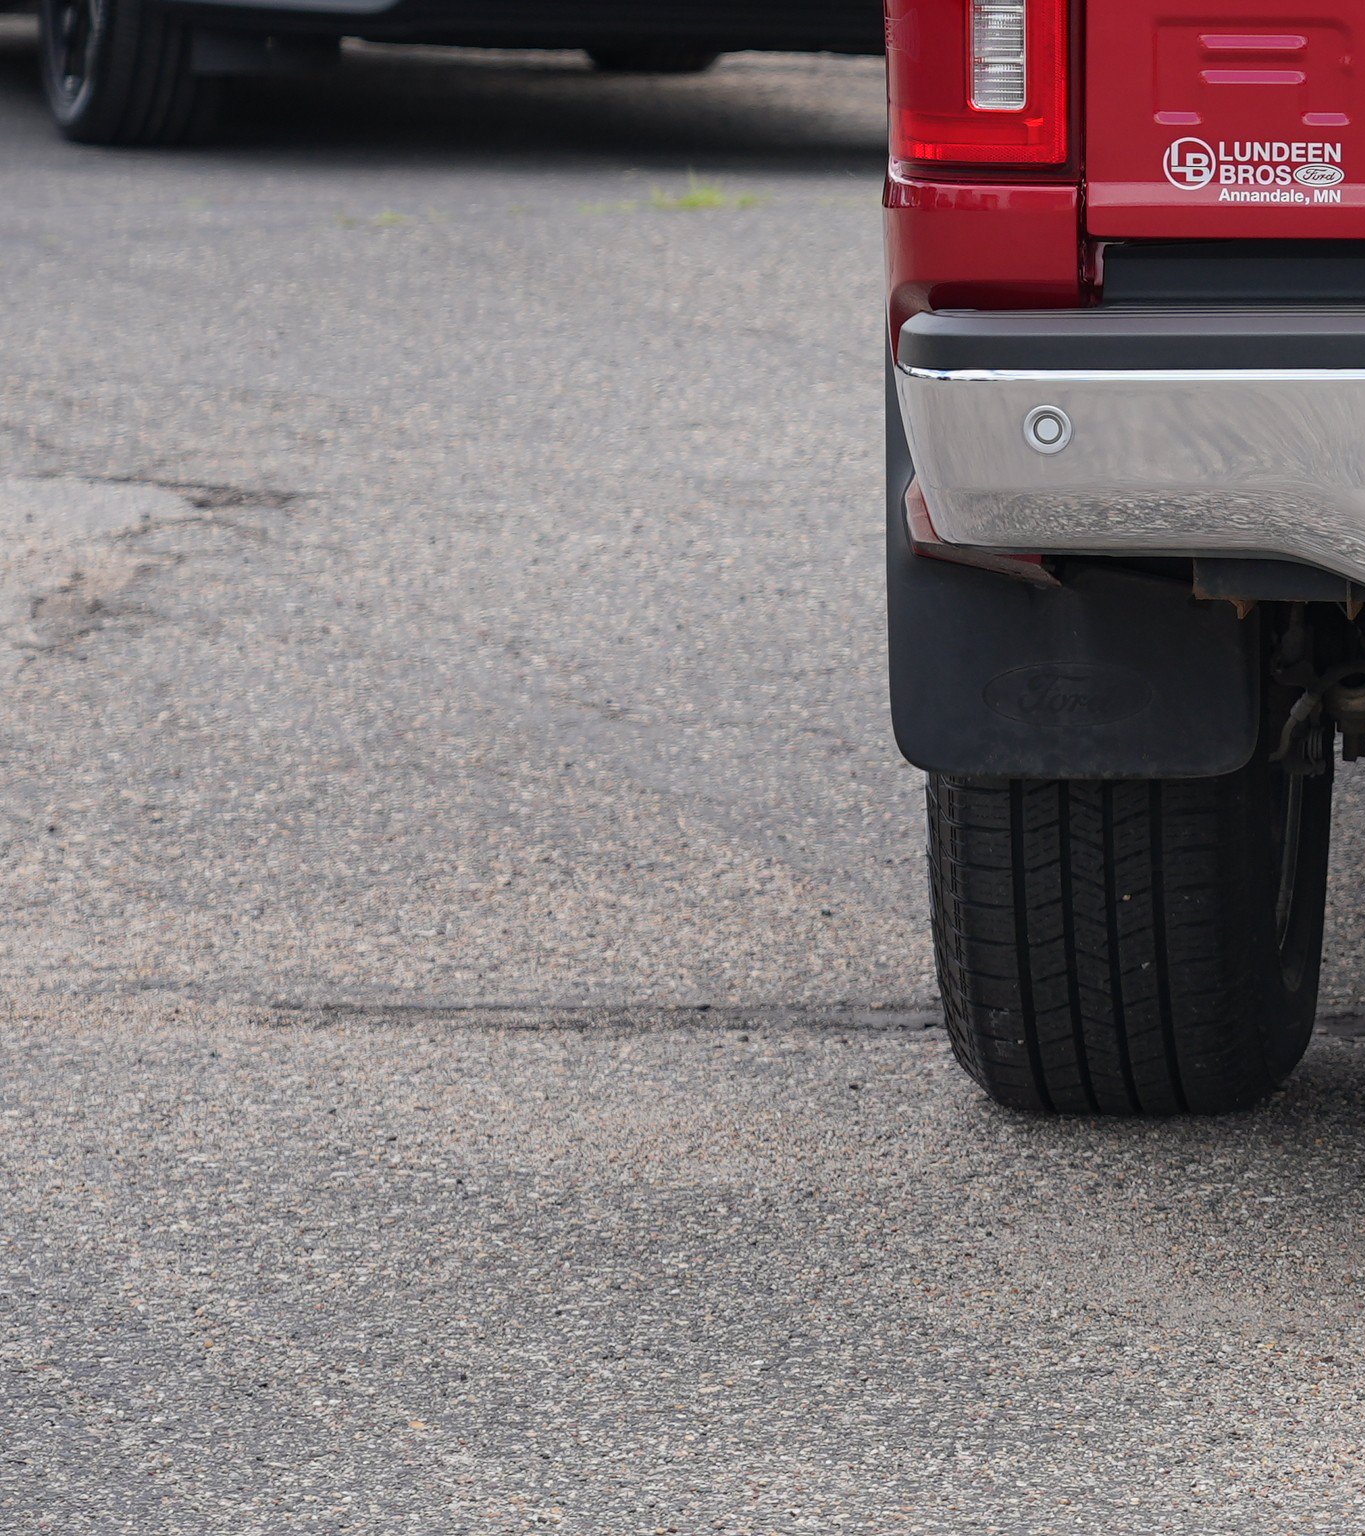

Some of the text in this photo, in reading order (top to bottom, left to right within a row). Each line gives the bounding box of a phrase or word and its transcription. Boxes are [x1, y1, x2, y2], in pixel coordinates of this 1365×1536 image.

[1218, 141, 1342, 163] LUNDEEN
[1219, 164, 1292, 186] BROS
[1218, 187, 1342, 205] Annandale, MN
